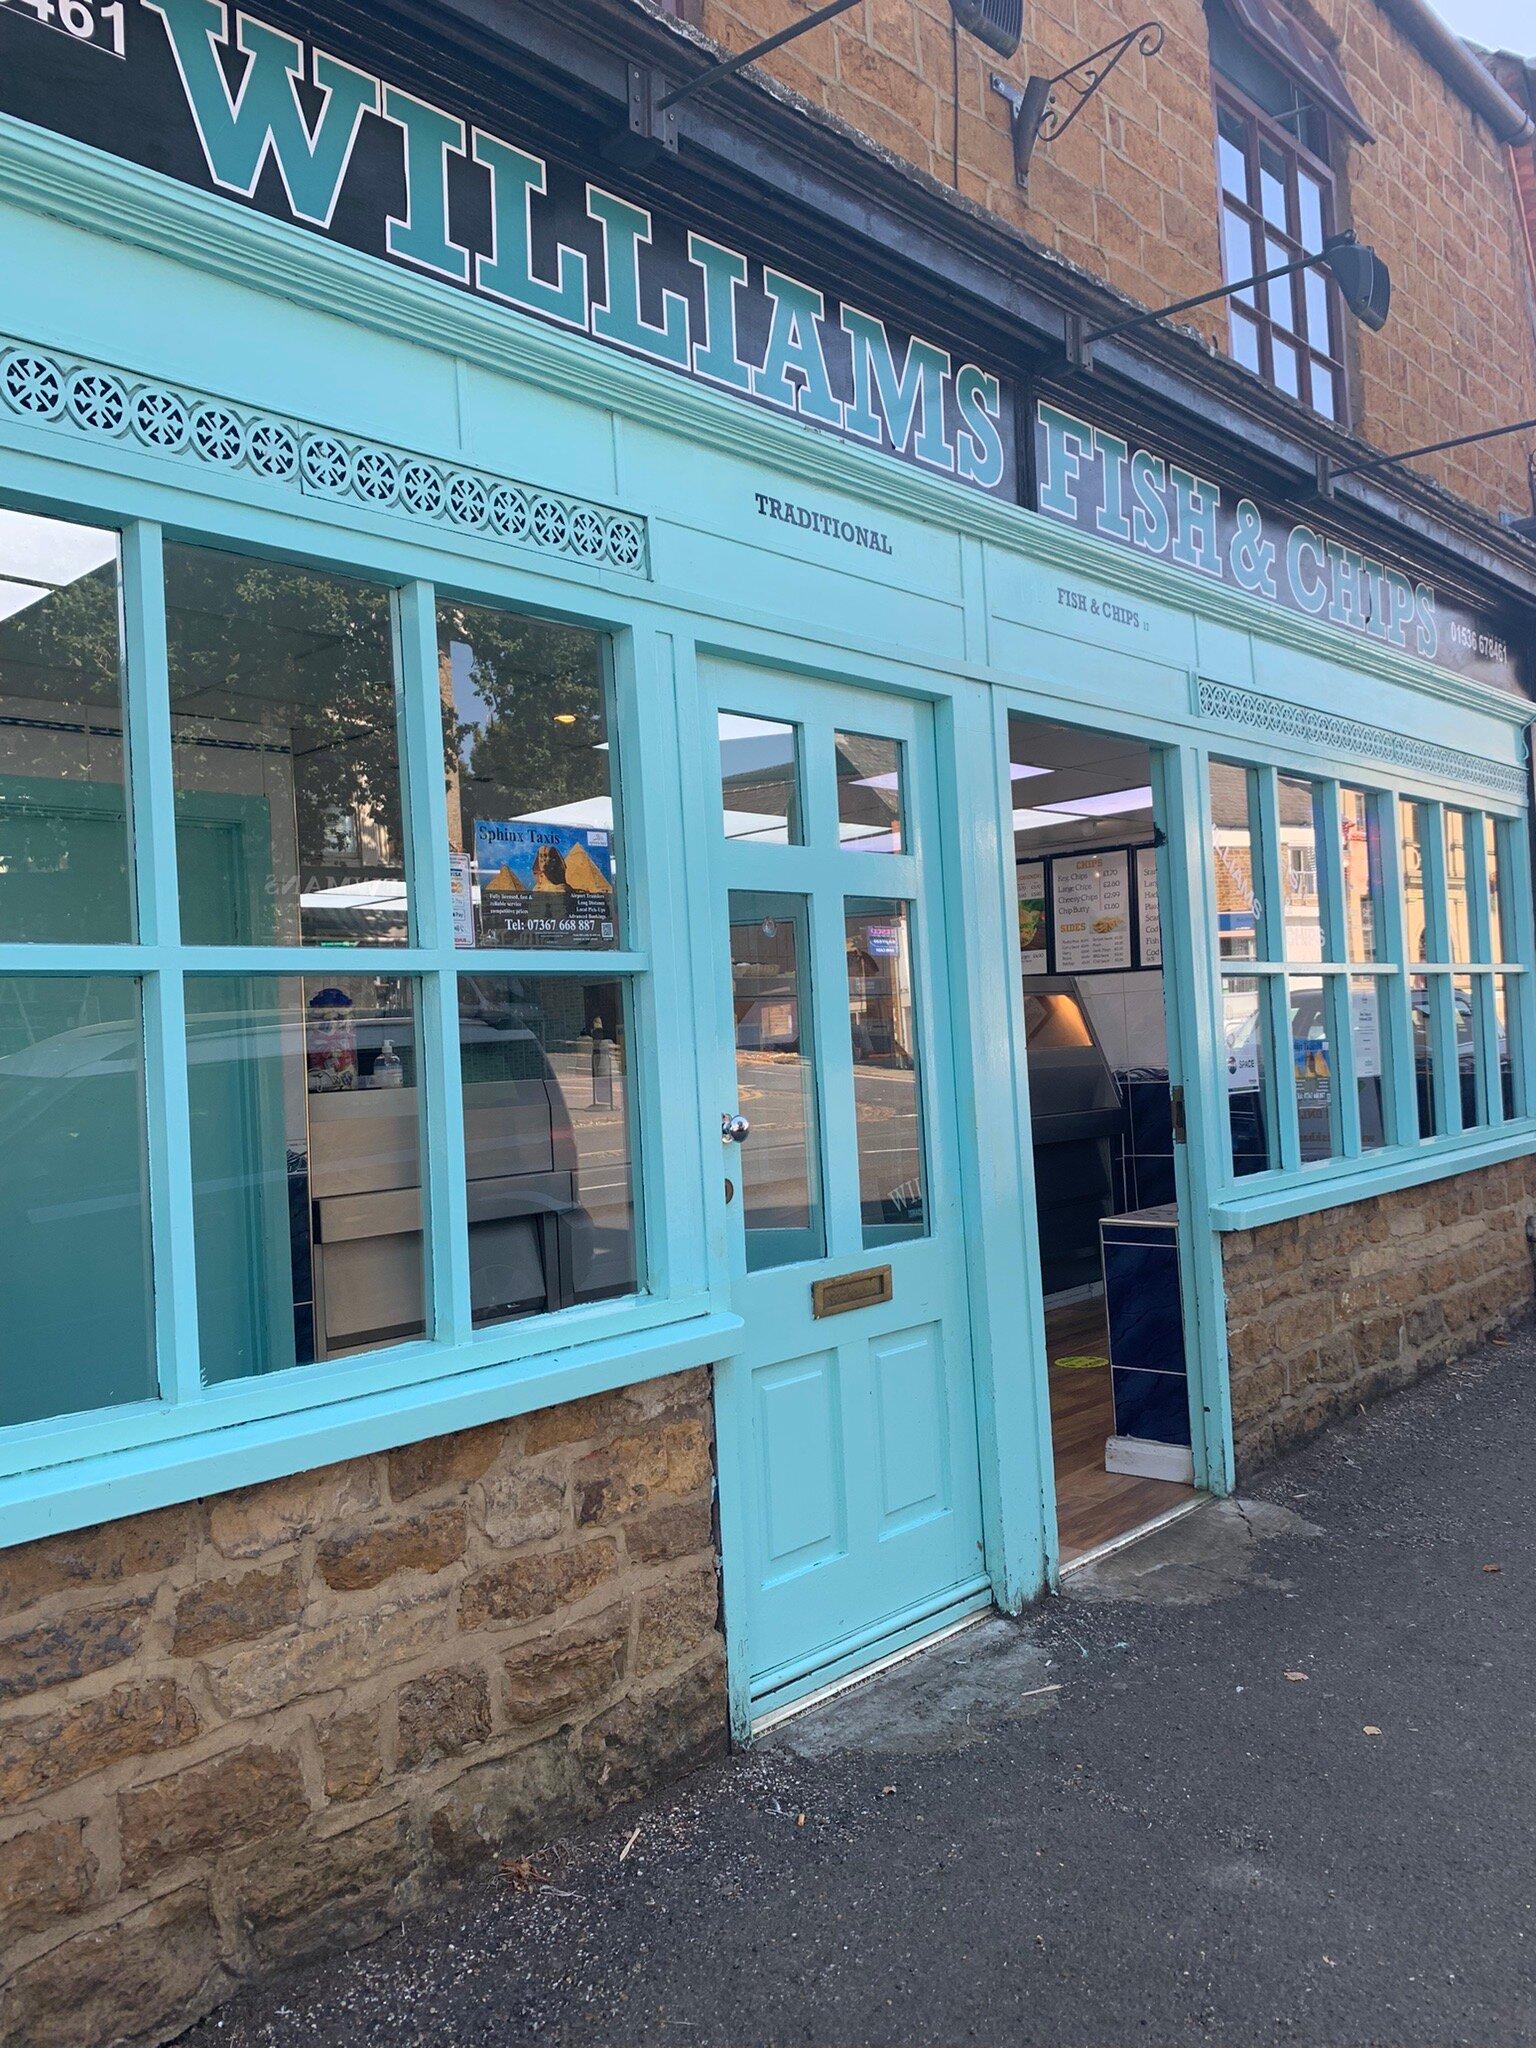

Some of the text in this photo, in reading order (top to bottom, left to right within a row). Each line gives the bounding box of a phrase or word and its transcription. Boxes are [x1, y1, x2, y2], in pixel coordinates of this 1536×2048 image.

[0, 0, 125, 56] 461
[141, 0, 1004, 488] WILLIAMS
[754, 492, 893, 555] TRADITIONAL
[1037, 399, 1439, 660] FISH & CHIPS
[1056, 587, 1088, 612] FISH
[1090, 598, 1100, 616] &
[1102, 601, 1140, 628] CHIPS
[1450, 621, 1508, 665] 01536 678461
[479, 825, 561, 845] Sphinx Taxis
[1070, 872, 1089, 881] Chips
[504, 918, 595, 931] Tel: 07367 668 887
[1060, 922, 1086, 933] SIDES
